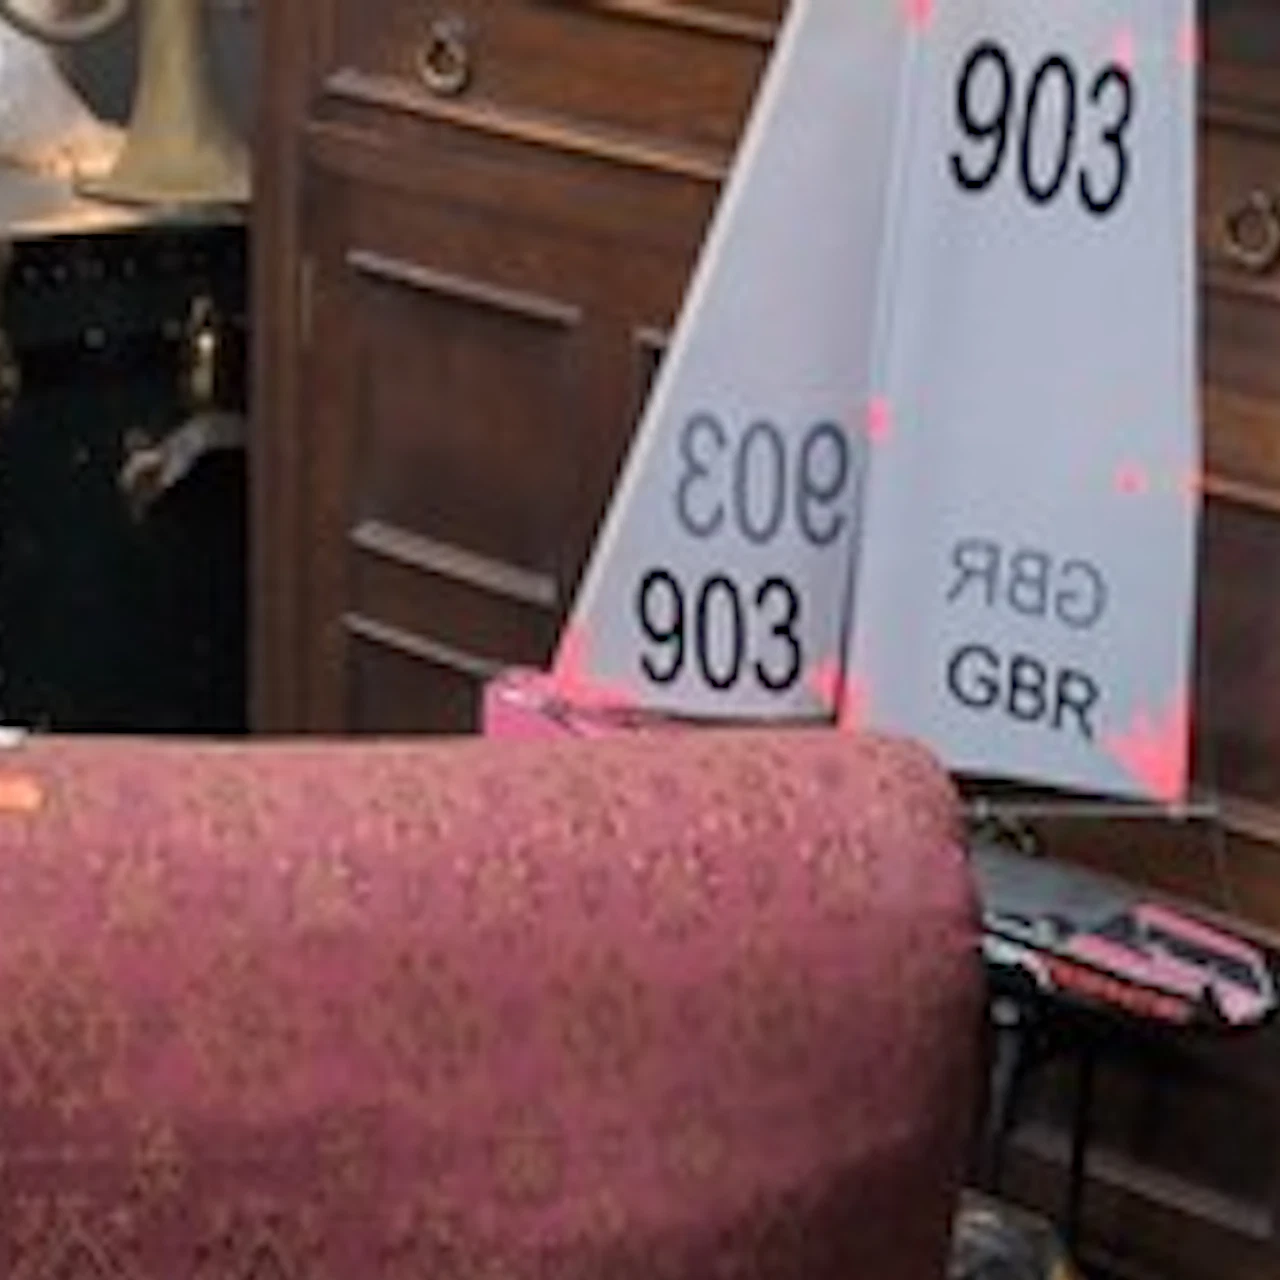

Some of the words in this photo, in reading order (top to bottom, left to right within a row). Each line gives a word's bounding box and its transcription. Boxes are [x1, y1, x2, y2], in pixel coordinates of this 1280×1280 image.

[949, 41, 1134, 216] 903
[634, 569, 803, 692] 903
[947, 644, 1101, 739] GBR
